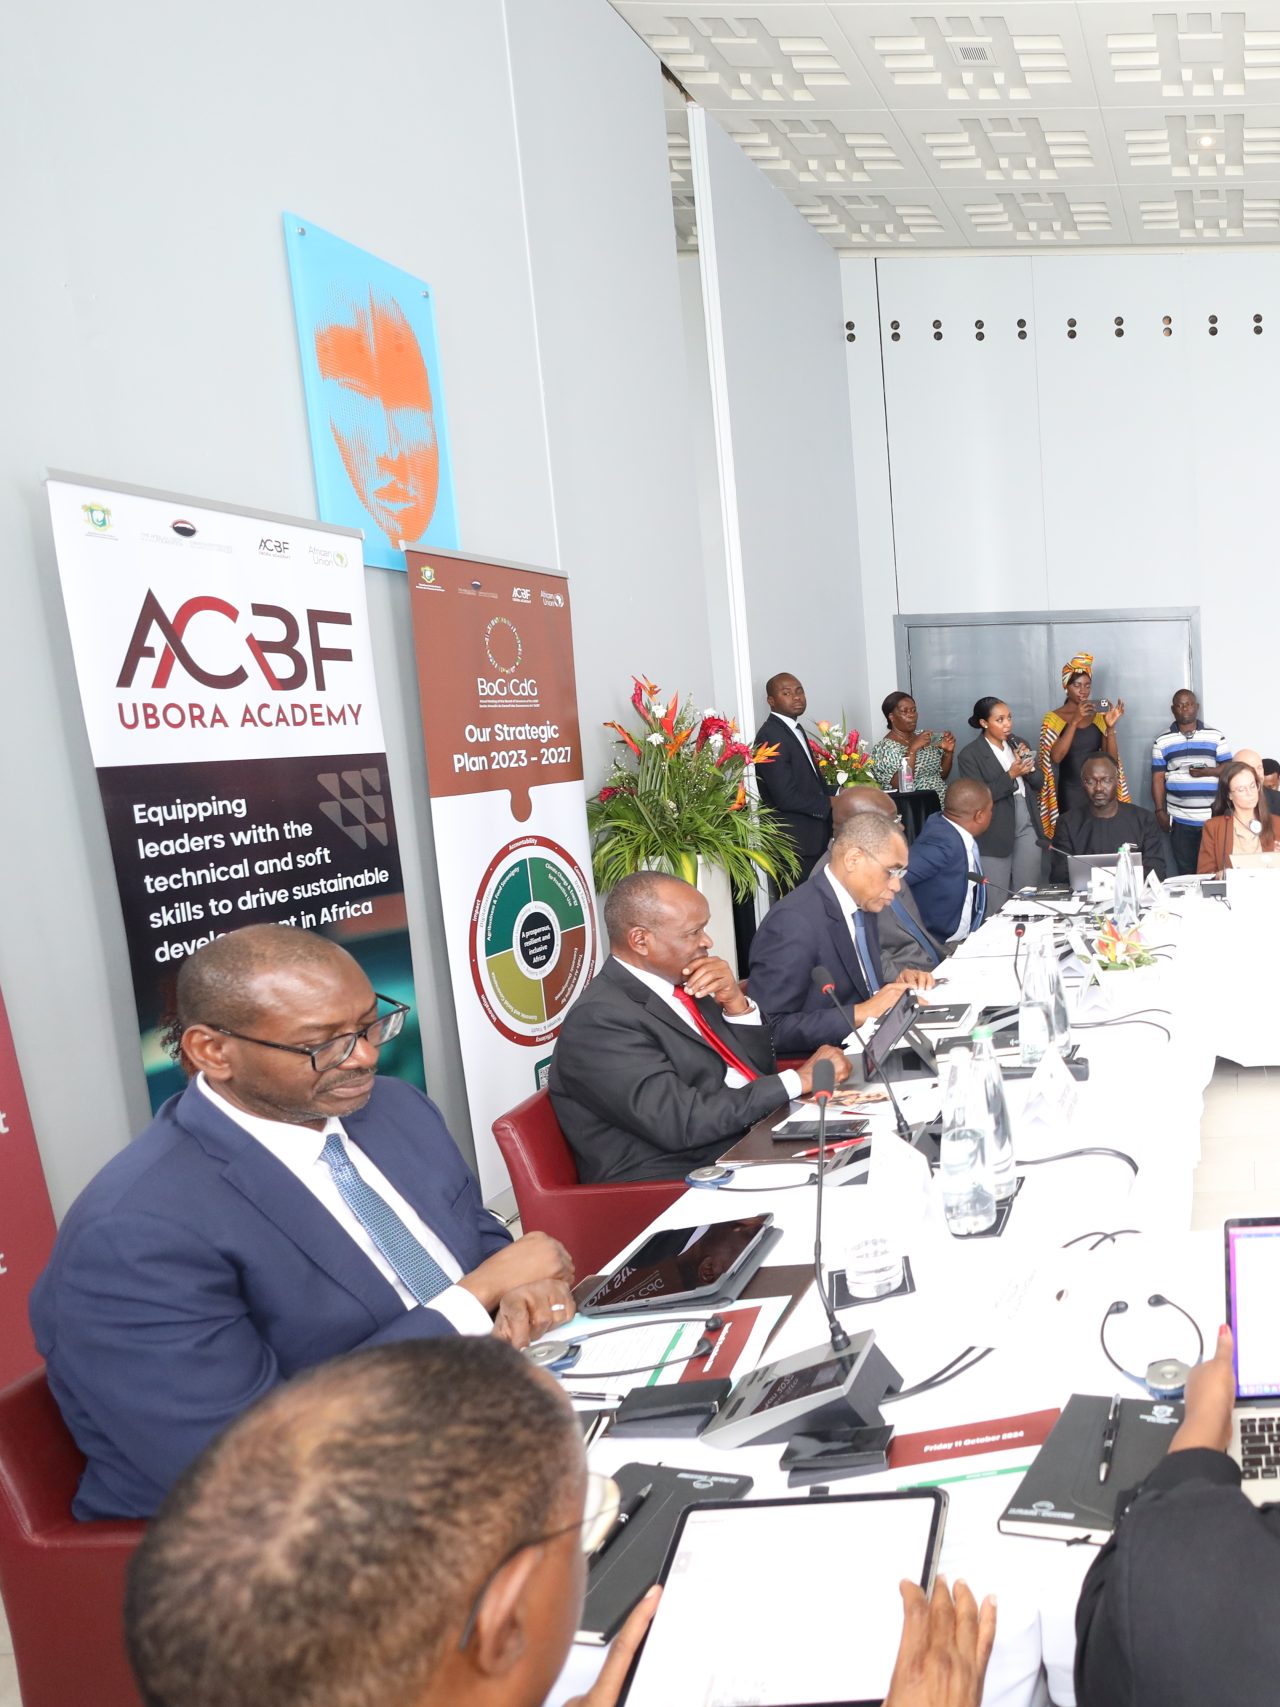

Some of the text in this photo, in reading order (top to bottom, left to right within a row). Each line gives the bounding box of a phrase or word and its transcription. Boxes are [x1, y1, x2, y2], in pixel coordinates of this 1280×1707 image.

[258, 537, 290, 554] ACBF
[308, 545, 333, 558] African
[312, 553, 334, 567] Union
[512, 587, 531, 599] ACBF
[115, 587, 353, 691] ACBF
[510, 678, 538, 696] CdG
[117, 702, 362, 730] UBORA ACADEMY
[464, 720, 560, 743] Our Strategic
[453, 752, 489, 773] Plan
[490, 749, 528, 770] 2023
[540, 746, 571, 765] 2027
[132, 795, 248, 827] Equipping
[138, 820, 313, 860] leaders with the
[143, 847, 332, 894] technical and soft
[149, 867, 390, 929] skills to drive sustainable
[300, 911, 317, 929] in
[320, 900, 373, 925] Africa
[472, 899, 481, 922] Impact
[532, 954, 546, 964] Africa
[923, 1430, 1024, 1453] Friday 11 October 2024
